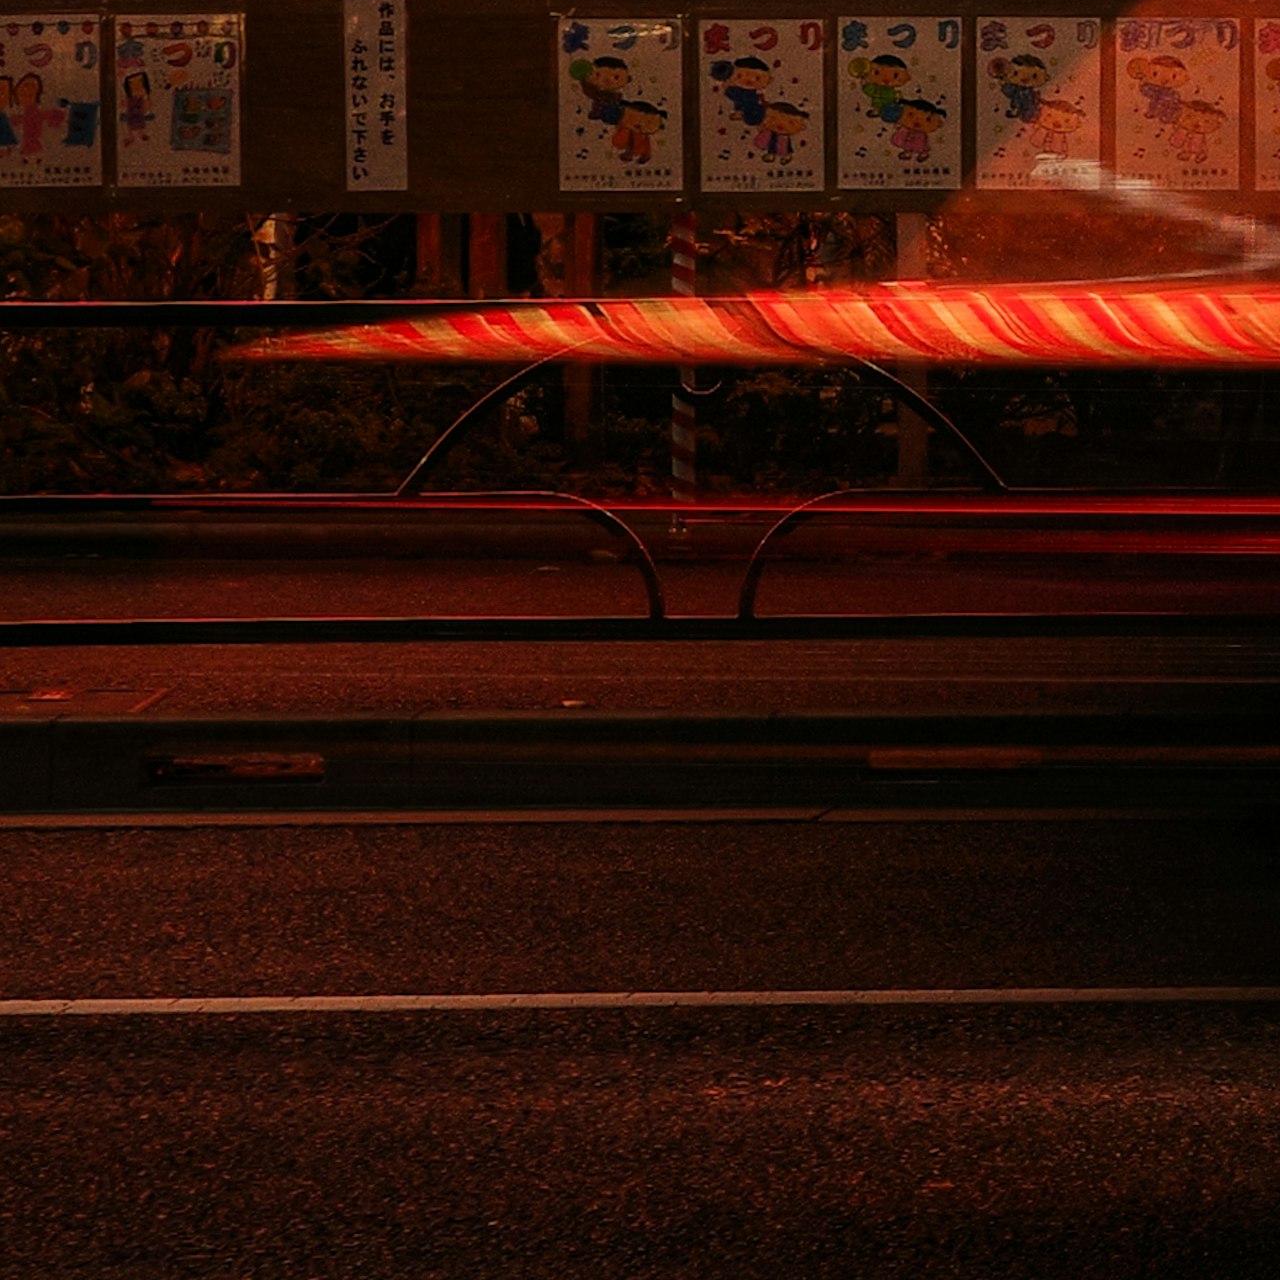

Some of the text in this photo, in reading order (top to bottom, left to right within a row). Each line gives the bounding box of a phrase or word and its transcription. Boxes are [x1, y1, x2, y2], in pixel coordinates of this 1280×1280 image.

[563, 21, 680, 53] まつり
[702, 21, 823, 54] まつり
[841, 20, 960, 52] まつり
[979, 22, 1098, 51] まつり
[1119, 20, 1238, 52] まつり
[352, 41, 368, 180] ふれないで下さい
